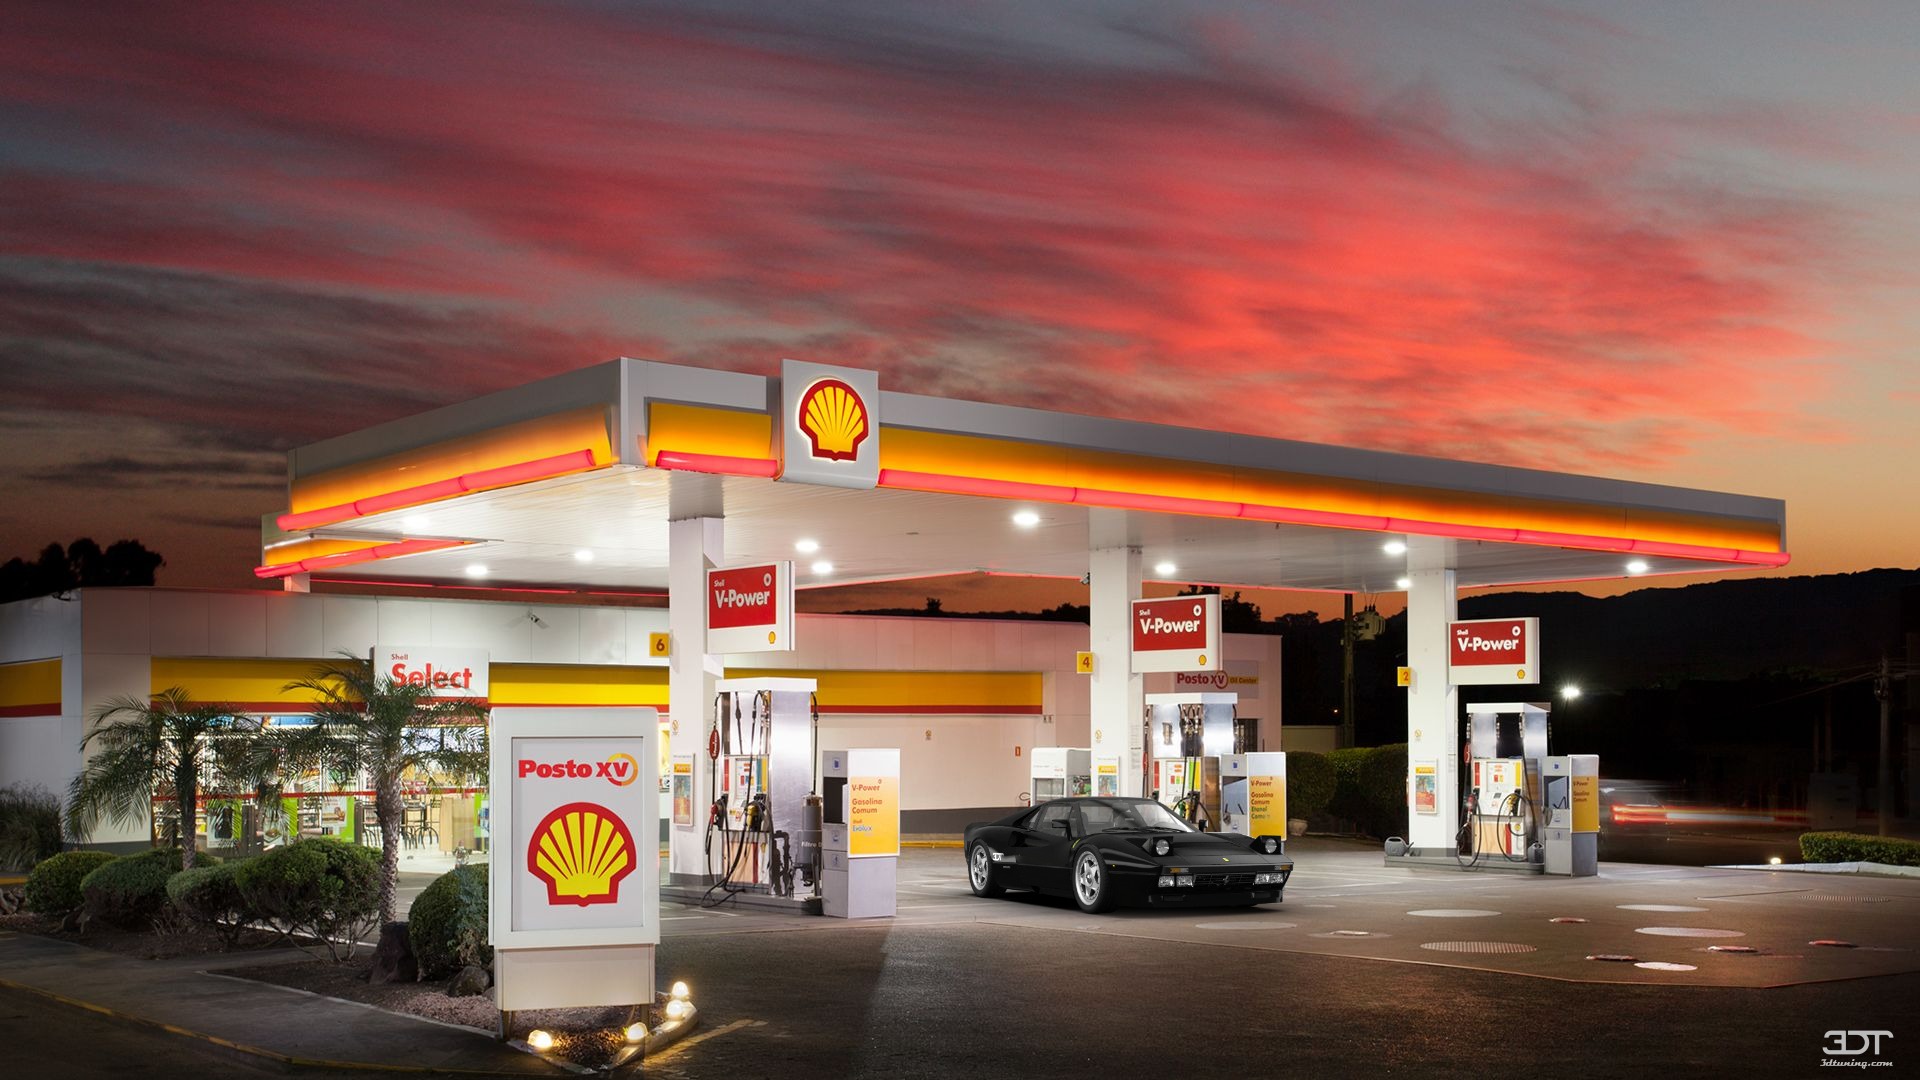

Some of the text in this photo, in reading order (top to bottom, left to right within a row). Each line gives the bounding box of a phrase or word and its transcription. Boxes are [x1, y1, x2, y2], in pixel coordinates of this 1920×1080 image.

[714, 579, 725, 588] Shell
[715, 589, 771, 609] V-Power
[1139, 608, 1151, 616] Shell
[1139, 617, 1201, 635] V-Power
[656, 639, 665, 652] 6
[1457, 637, 1519, 652] V-Power
[1082, 657, 1090, 668] 4
[391, 663, 472, 689] Select
[1177, 672, 1209, 685] Posto
[1403, 671, 1409, 681] 2
[518, 759, 629, 778] Posto XV
[851, 797, 883, 806] Gasolina
[851, 806, 878, 814] Comum
